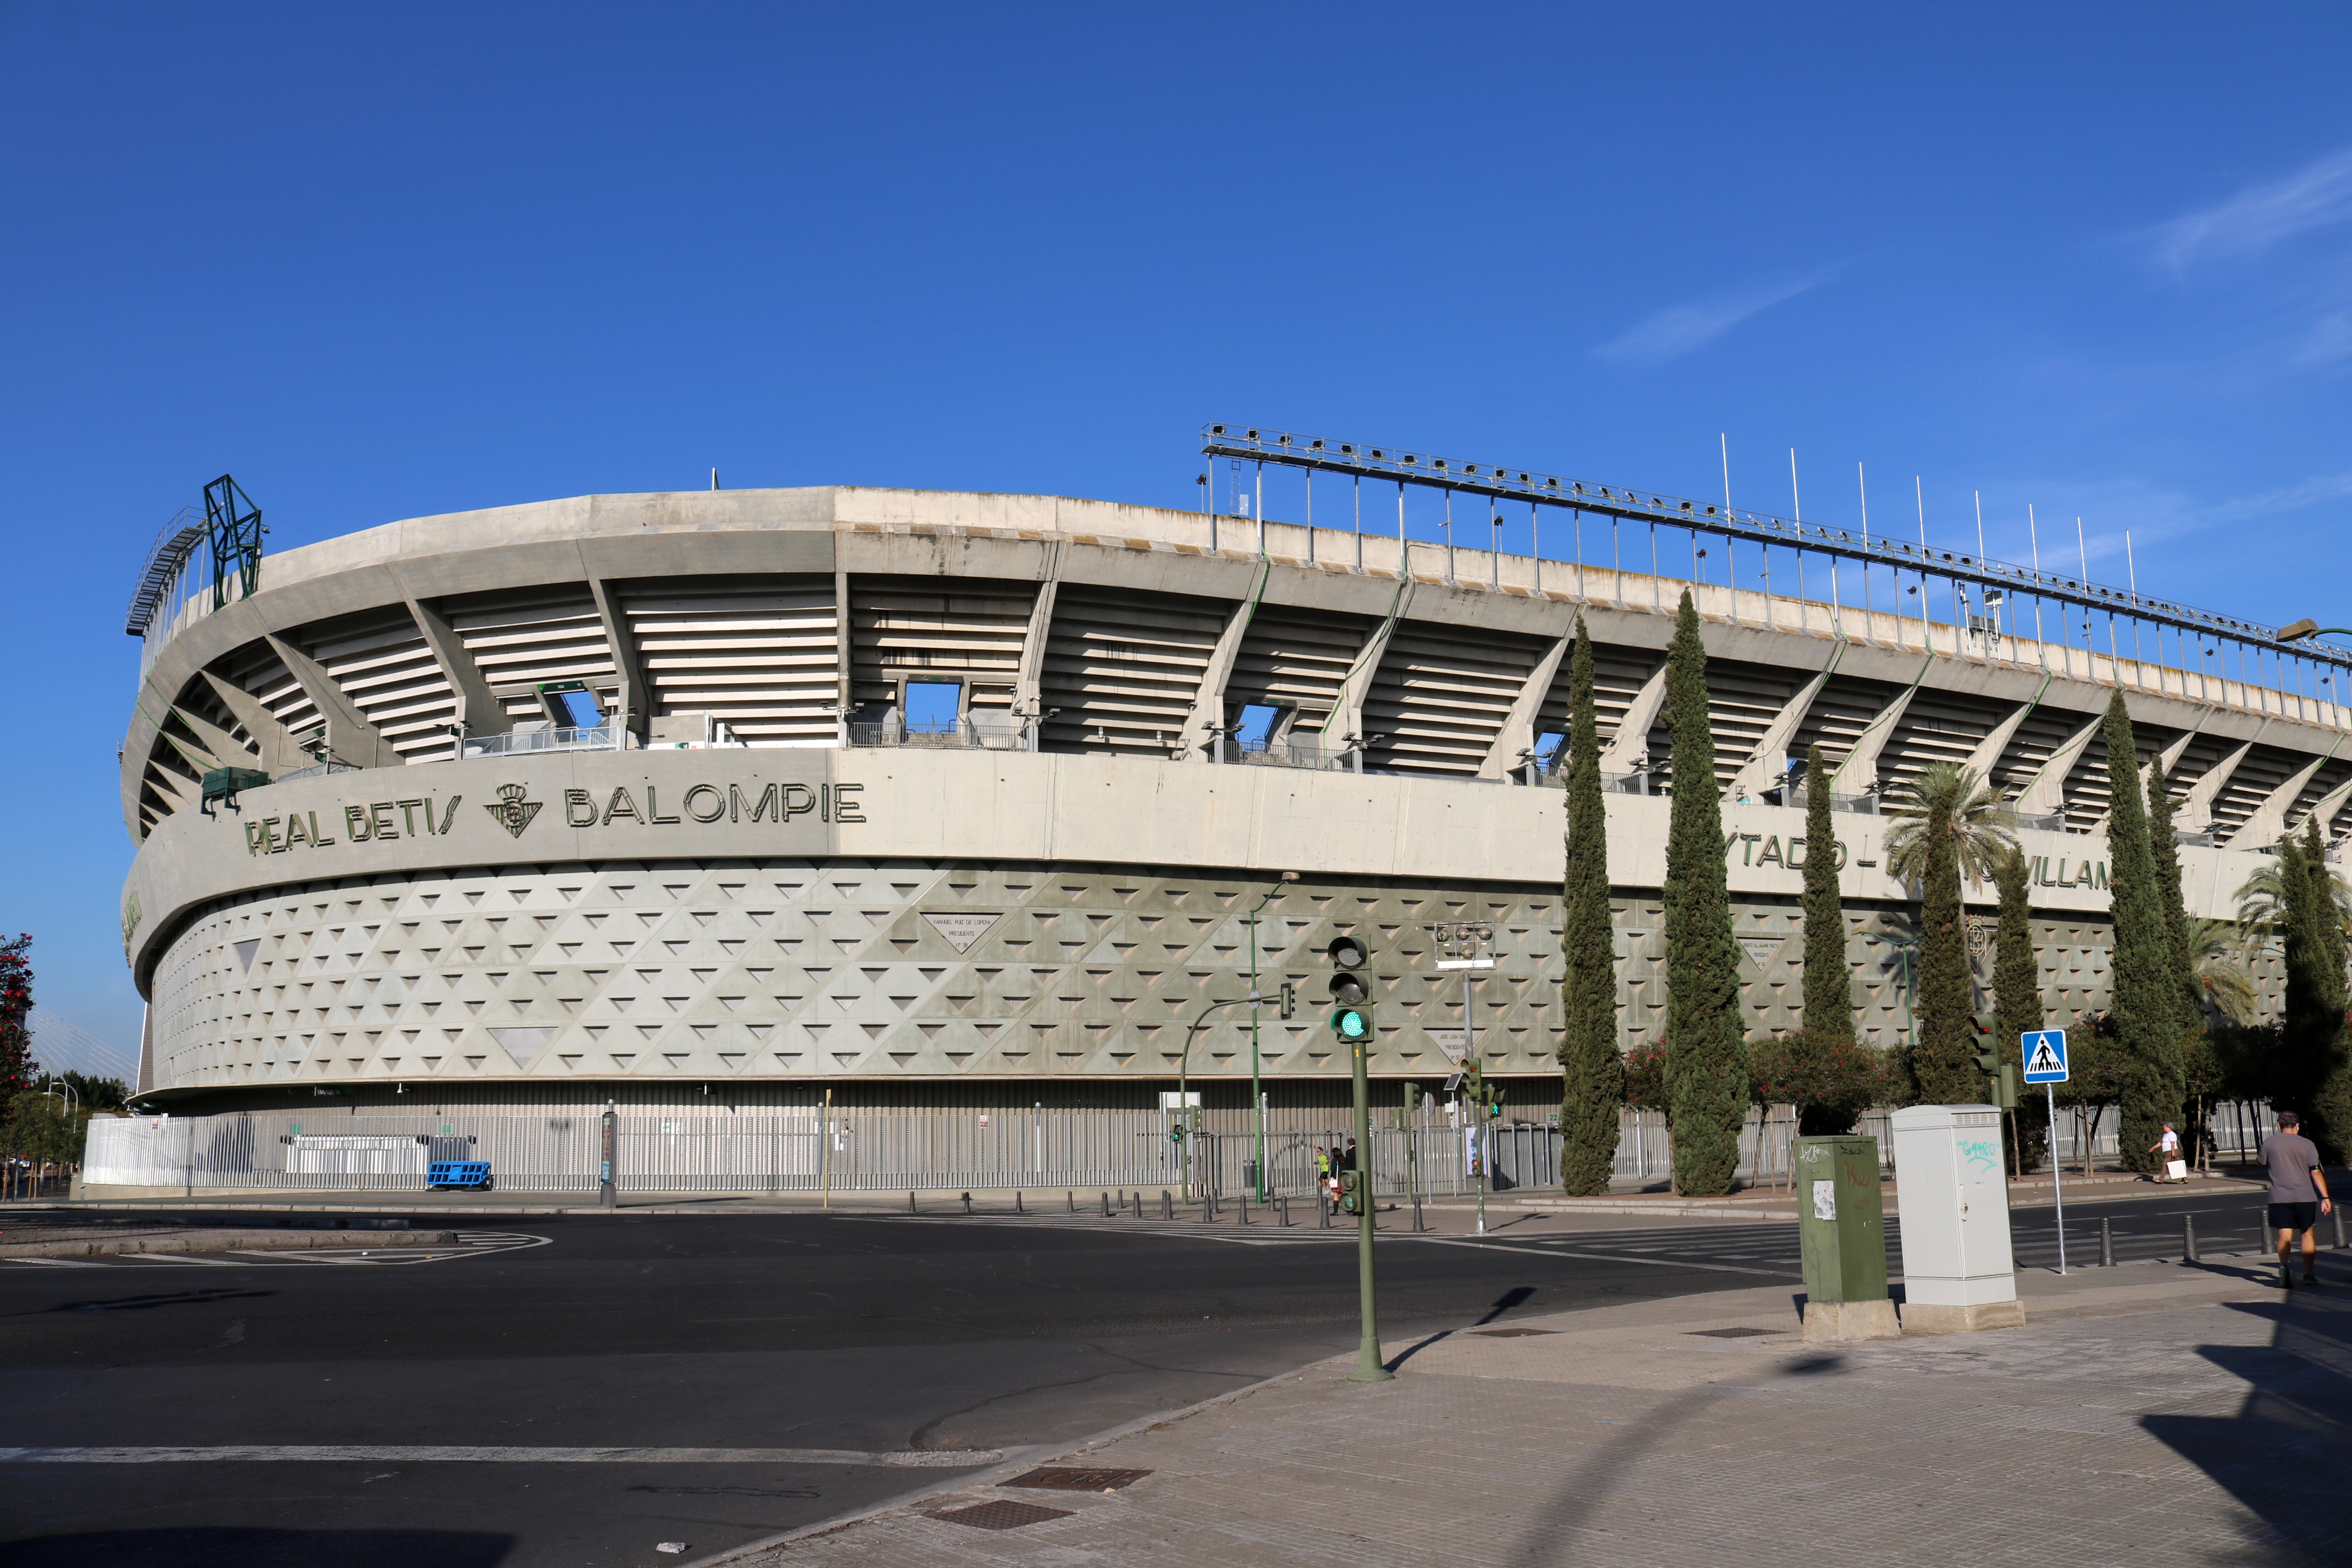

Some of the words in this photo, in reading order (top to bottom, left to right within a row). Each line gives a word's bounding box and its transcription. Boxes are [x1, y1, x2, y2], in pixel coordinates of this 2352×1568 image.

[244, 811, 335, 856] REAL
[564, 783, 867, 827] BALOMPIE
[1354, 1048, 1360, 1057] 1
